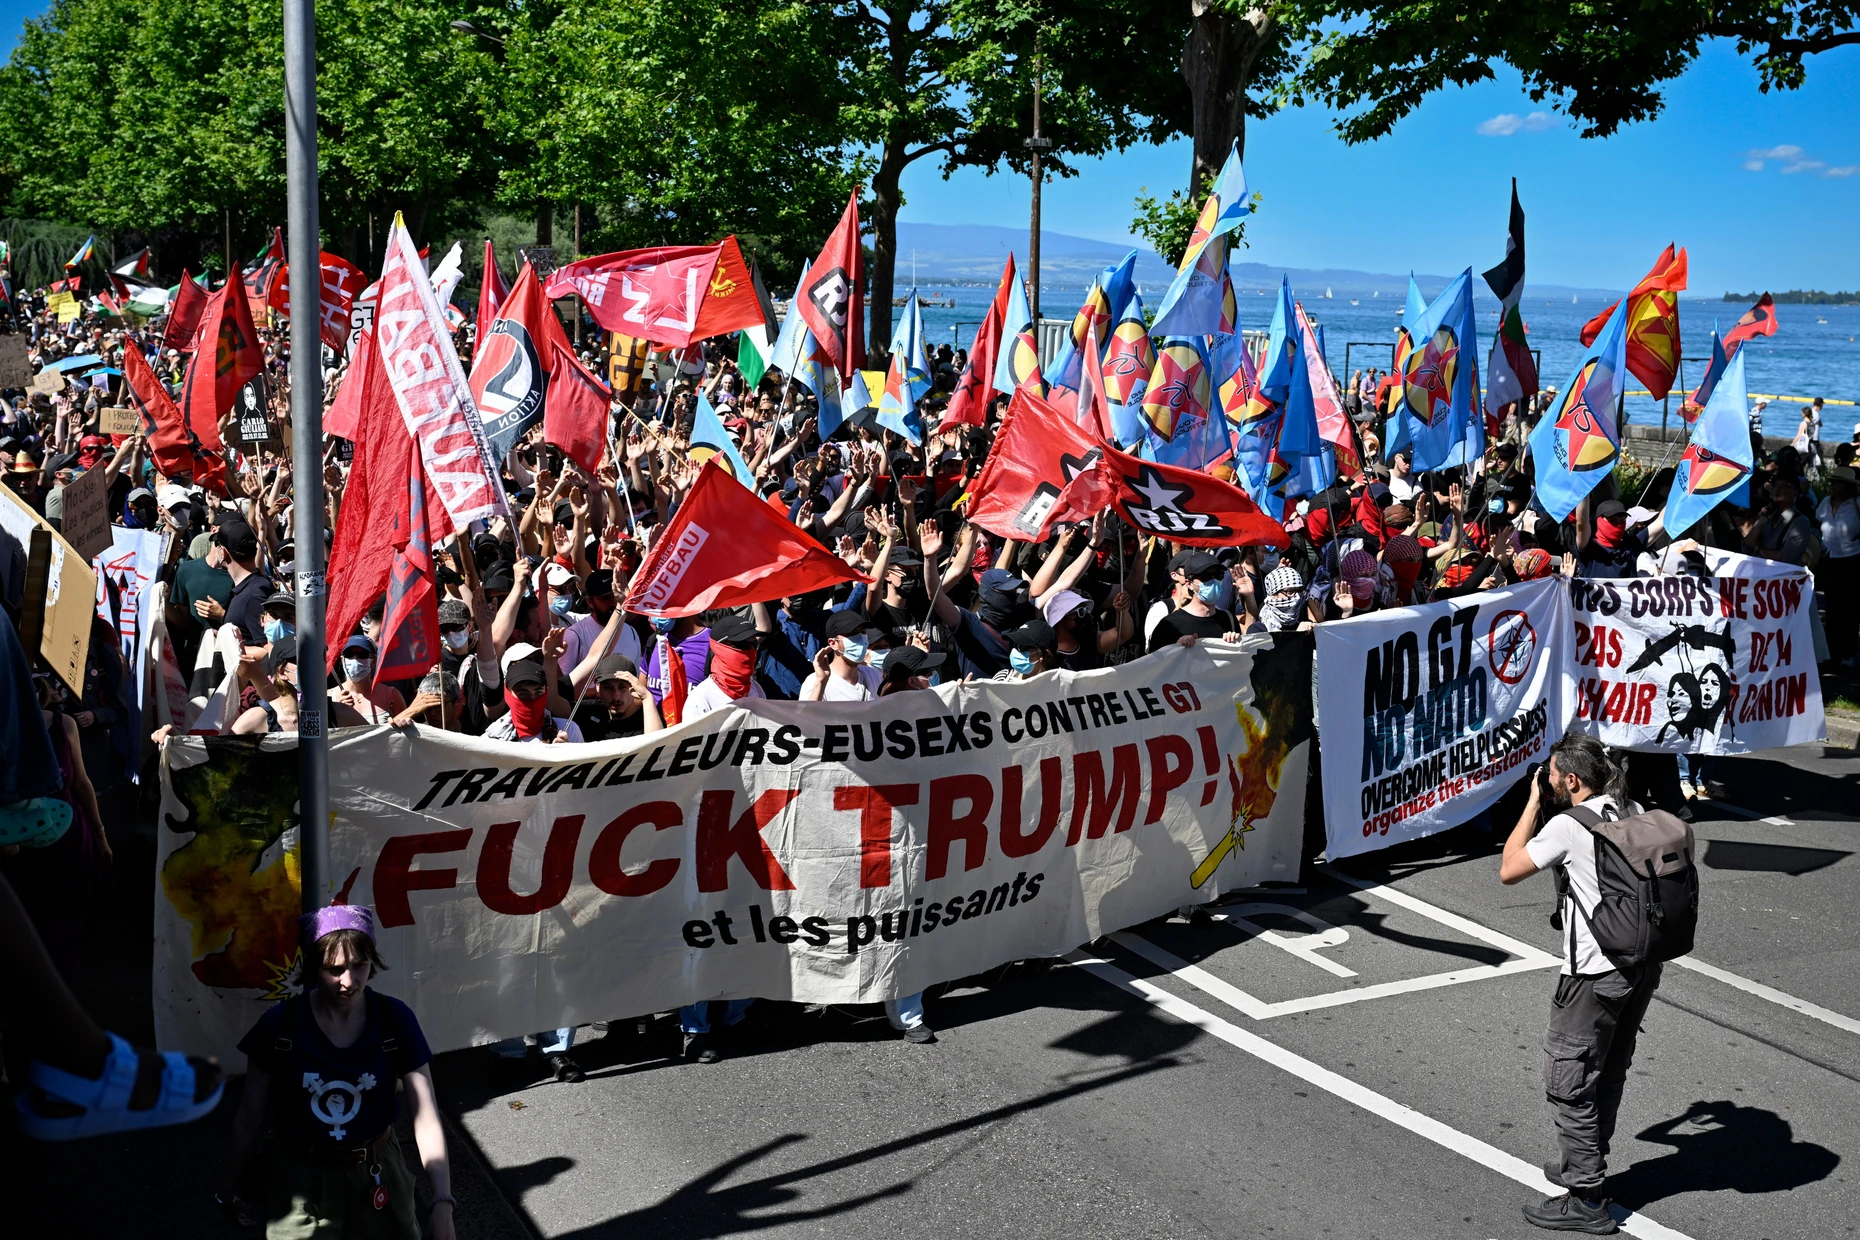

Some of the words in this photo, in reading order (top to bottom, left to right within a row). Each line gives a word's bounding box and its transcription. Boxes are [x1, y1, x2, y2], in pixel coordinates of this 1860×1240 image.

[241, 417, 265, 426] CARLO
[1128, 505, 1225, 534] RJZ
[639, 529, 700, 612] AUFBAU
[1628, 577, 1714, 619] CORPS
[1719, 578, 1749, 621] NE
[1363, 630, 1420, 720] NO
[1427, 603, 1481, 693] G7
[1575, 621, 1624, 669] PAS
[1361, 703, 1406, 784] NO
[1413, 665, 1488, 761] NATO
[1577, 676, 1657, 725] CHAIR
[1739, 672, 1808, 723] CANON
[412, 711, 993, 811] TRAVAILLEURS-EUSEXS
[1001, 694, 1124, 745] CONTRE
[1122, 687, 1165, 726] LE
[1161, 681, 1203, 715] G7
[1361, 750, 1448, 821] OVERCOME
[1449, 697, 1548, 777] HELPLESSNESS
[372, 789, 799, 928] FUCK
[833, 725, 1221, 891] TRUMP!
[1362, 791, 1436, 838] organize
[1438, 775, 1465, 803] the
[682, 909, 738, 951] et
[751, 904, 832, 949] les
[846, 870, 1046, 956] puissants
